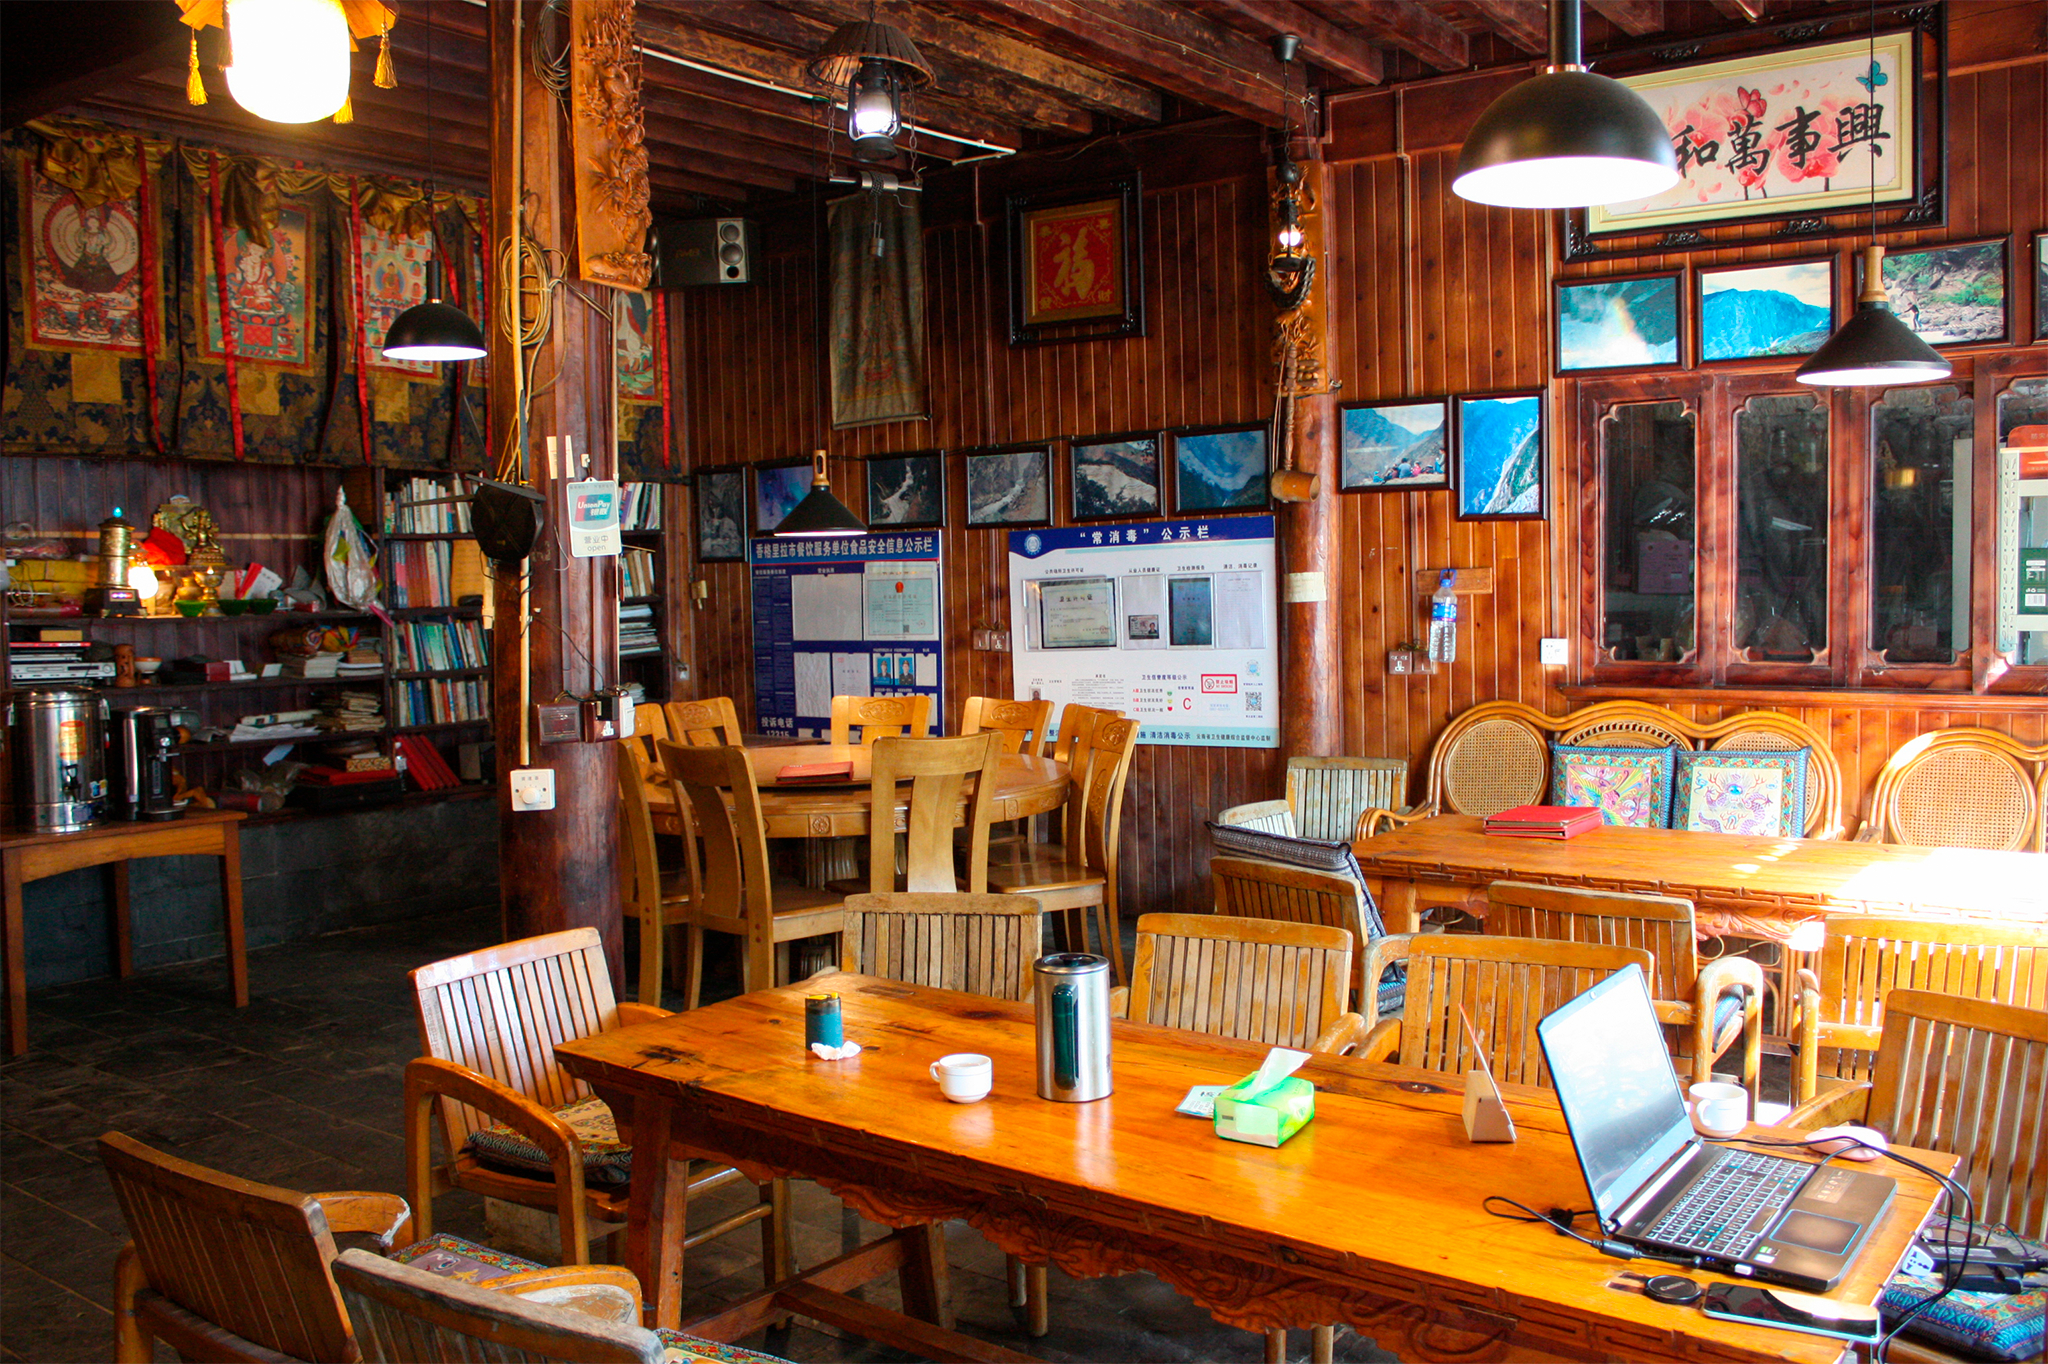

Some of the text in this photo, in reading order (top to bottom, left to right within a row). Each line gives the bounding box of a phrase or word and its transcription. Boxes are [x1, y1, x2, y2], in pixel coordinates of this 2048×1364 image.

[1053, 227, 1095, 300] 福
[578, 501, 611, 509] UnionPay
[584, 535, 609, 544] 营业中
[755, 537, 933, 559] 香格里拉市餐饮服务单位食品安全信息公示栏
[1182, 697, 1192, 711] C
[761, 716, 794, 729] 投诉电话
[1149, 731, 1191, 740] 清洁消毒公示
